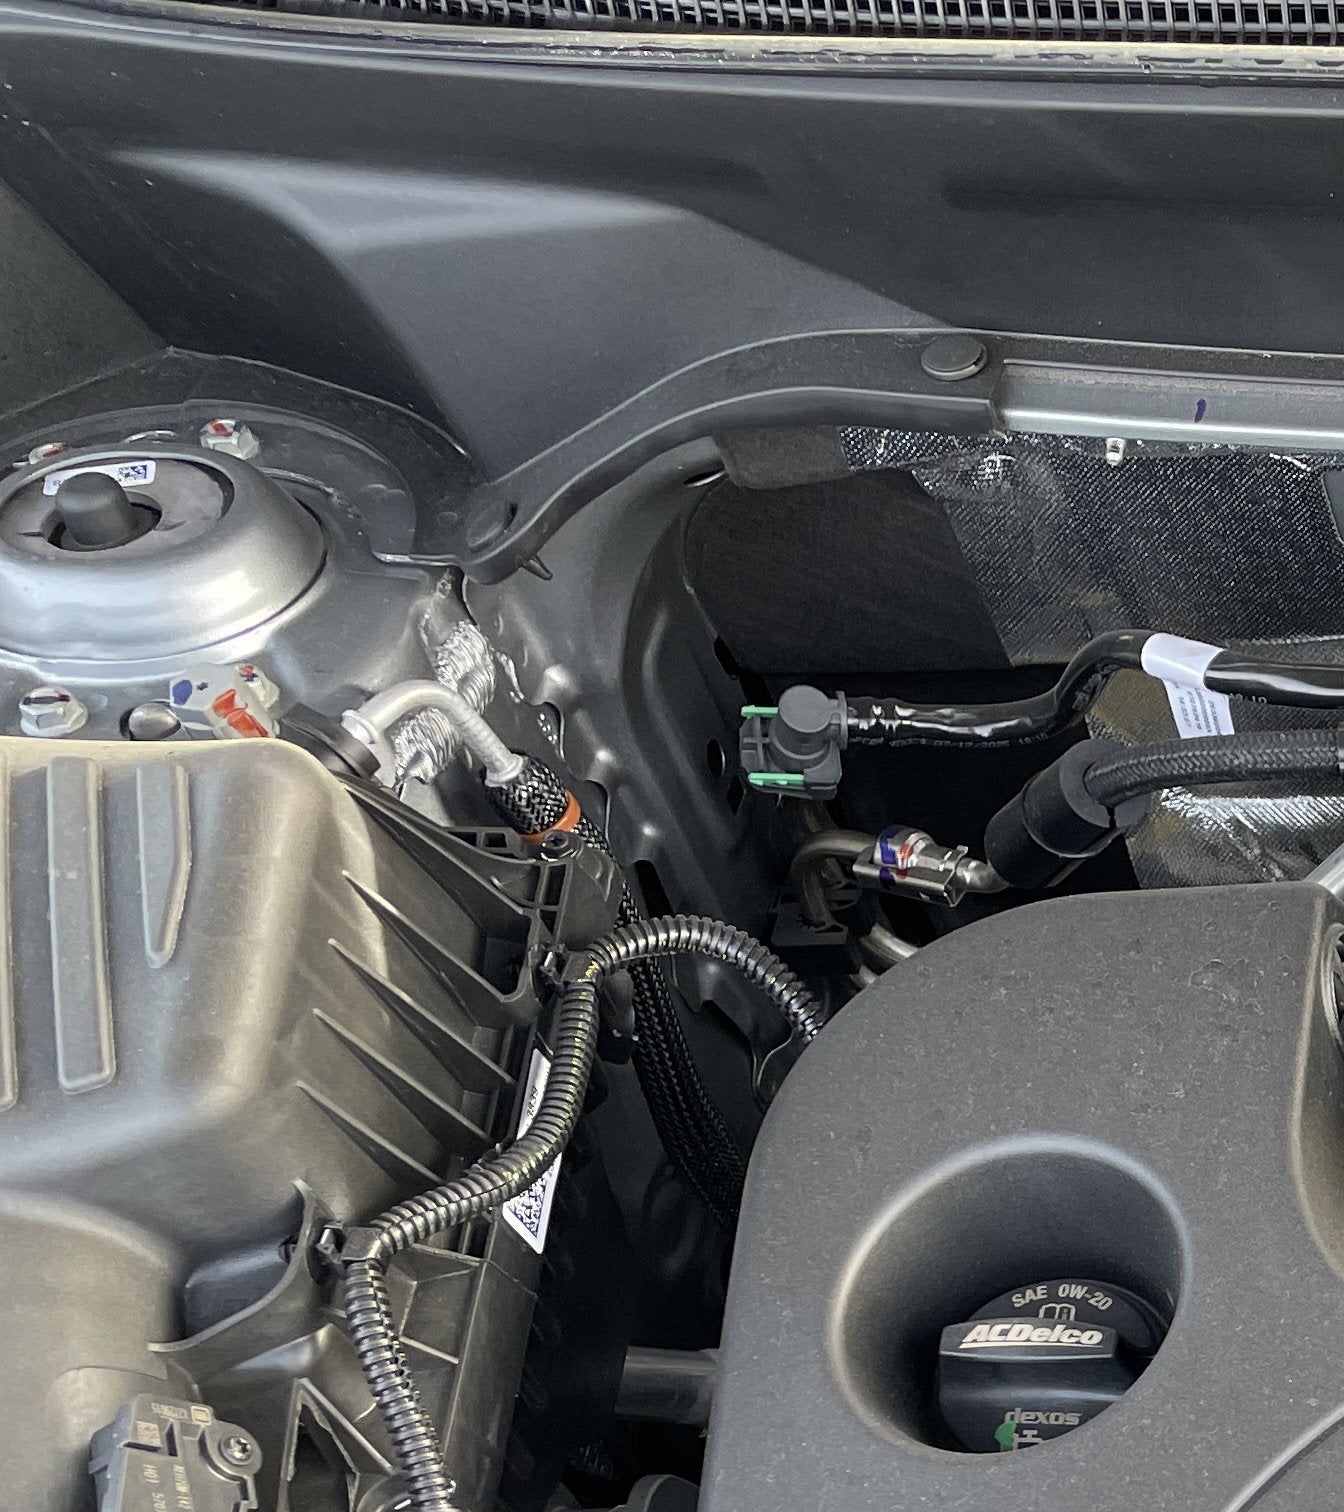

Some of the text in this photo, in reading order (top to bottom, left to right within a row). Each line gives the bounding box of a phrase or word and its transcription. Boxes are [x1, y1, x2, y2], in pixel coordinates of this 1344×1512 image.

[1012, 1283, 1113, 1311] SAE 0W-20
[961, 1323, 1104, 1346] ACDelco
[1004, 1407, 1083, 1425] dexos
